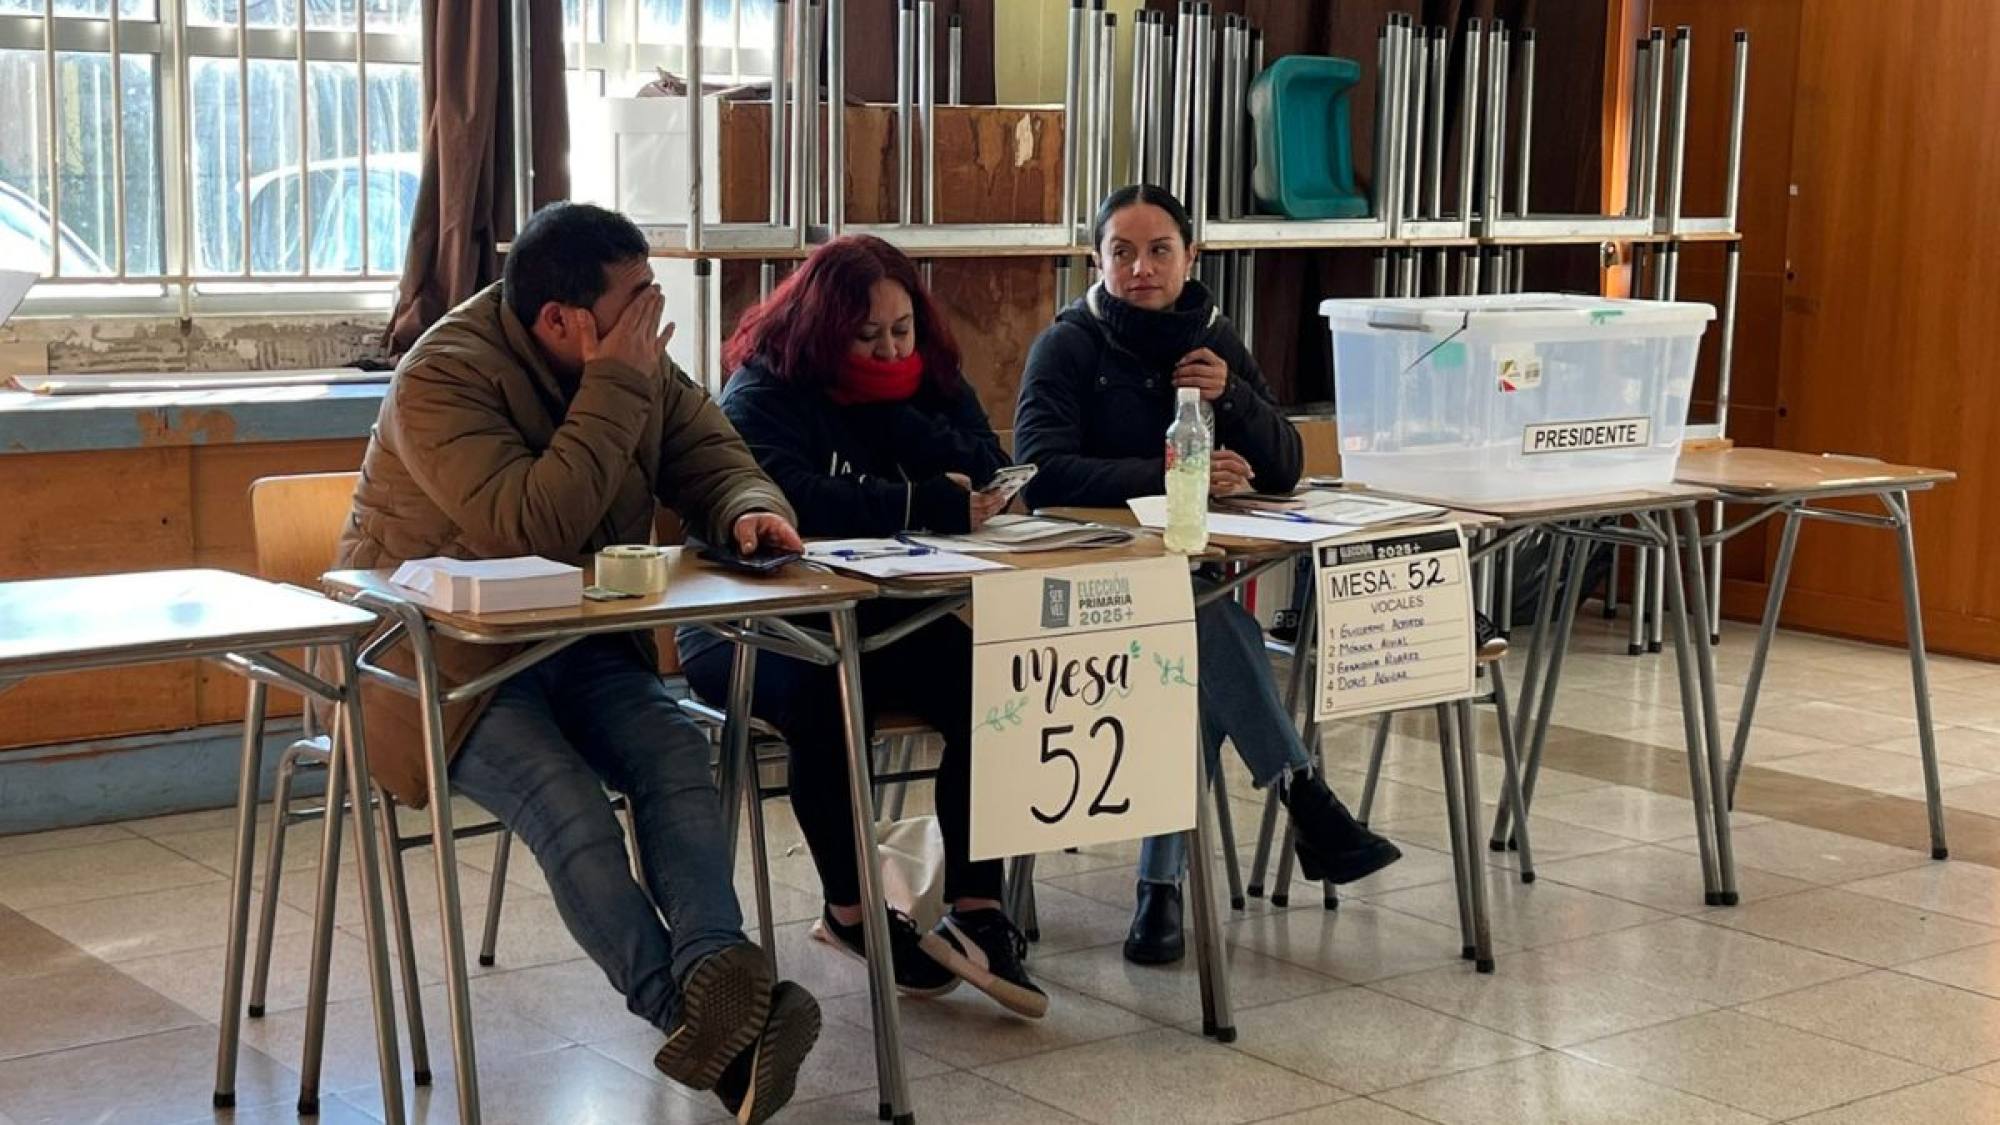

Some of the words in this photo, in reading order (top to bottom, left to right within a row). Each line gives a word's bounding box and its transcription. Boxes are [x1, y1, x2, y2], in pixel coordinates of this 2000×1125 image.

[1534, 424, 1638, 449] PRESIDENTE
[1331, 568, 1397, 599] MESA:
[1407, 557, 1446, 590] 52
[1079, 594, 1133, 610] PRIMARIA
[1370, 596, 1425, 615] VOCALES
[1079, 608, 1134, 626] 2025+
[1328, 644, 1335, 658] 2
[1327, 661, 1335, 675] 3
[1012, 646, 1130, 714] Mesa
[1326, 696, 1334, 710] 5
[1030, 716, 1131, 824] 52
